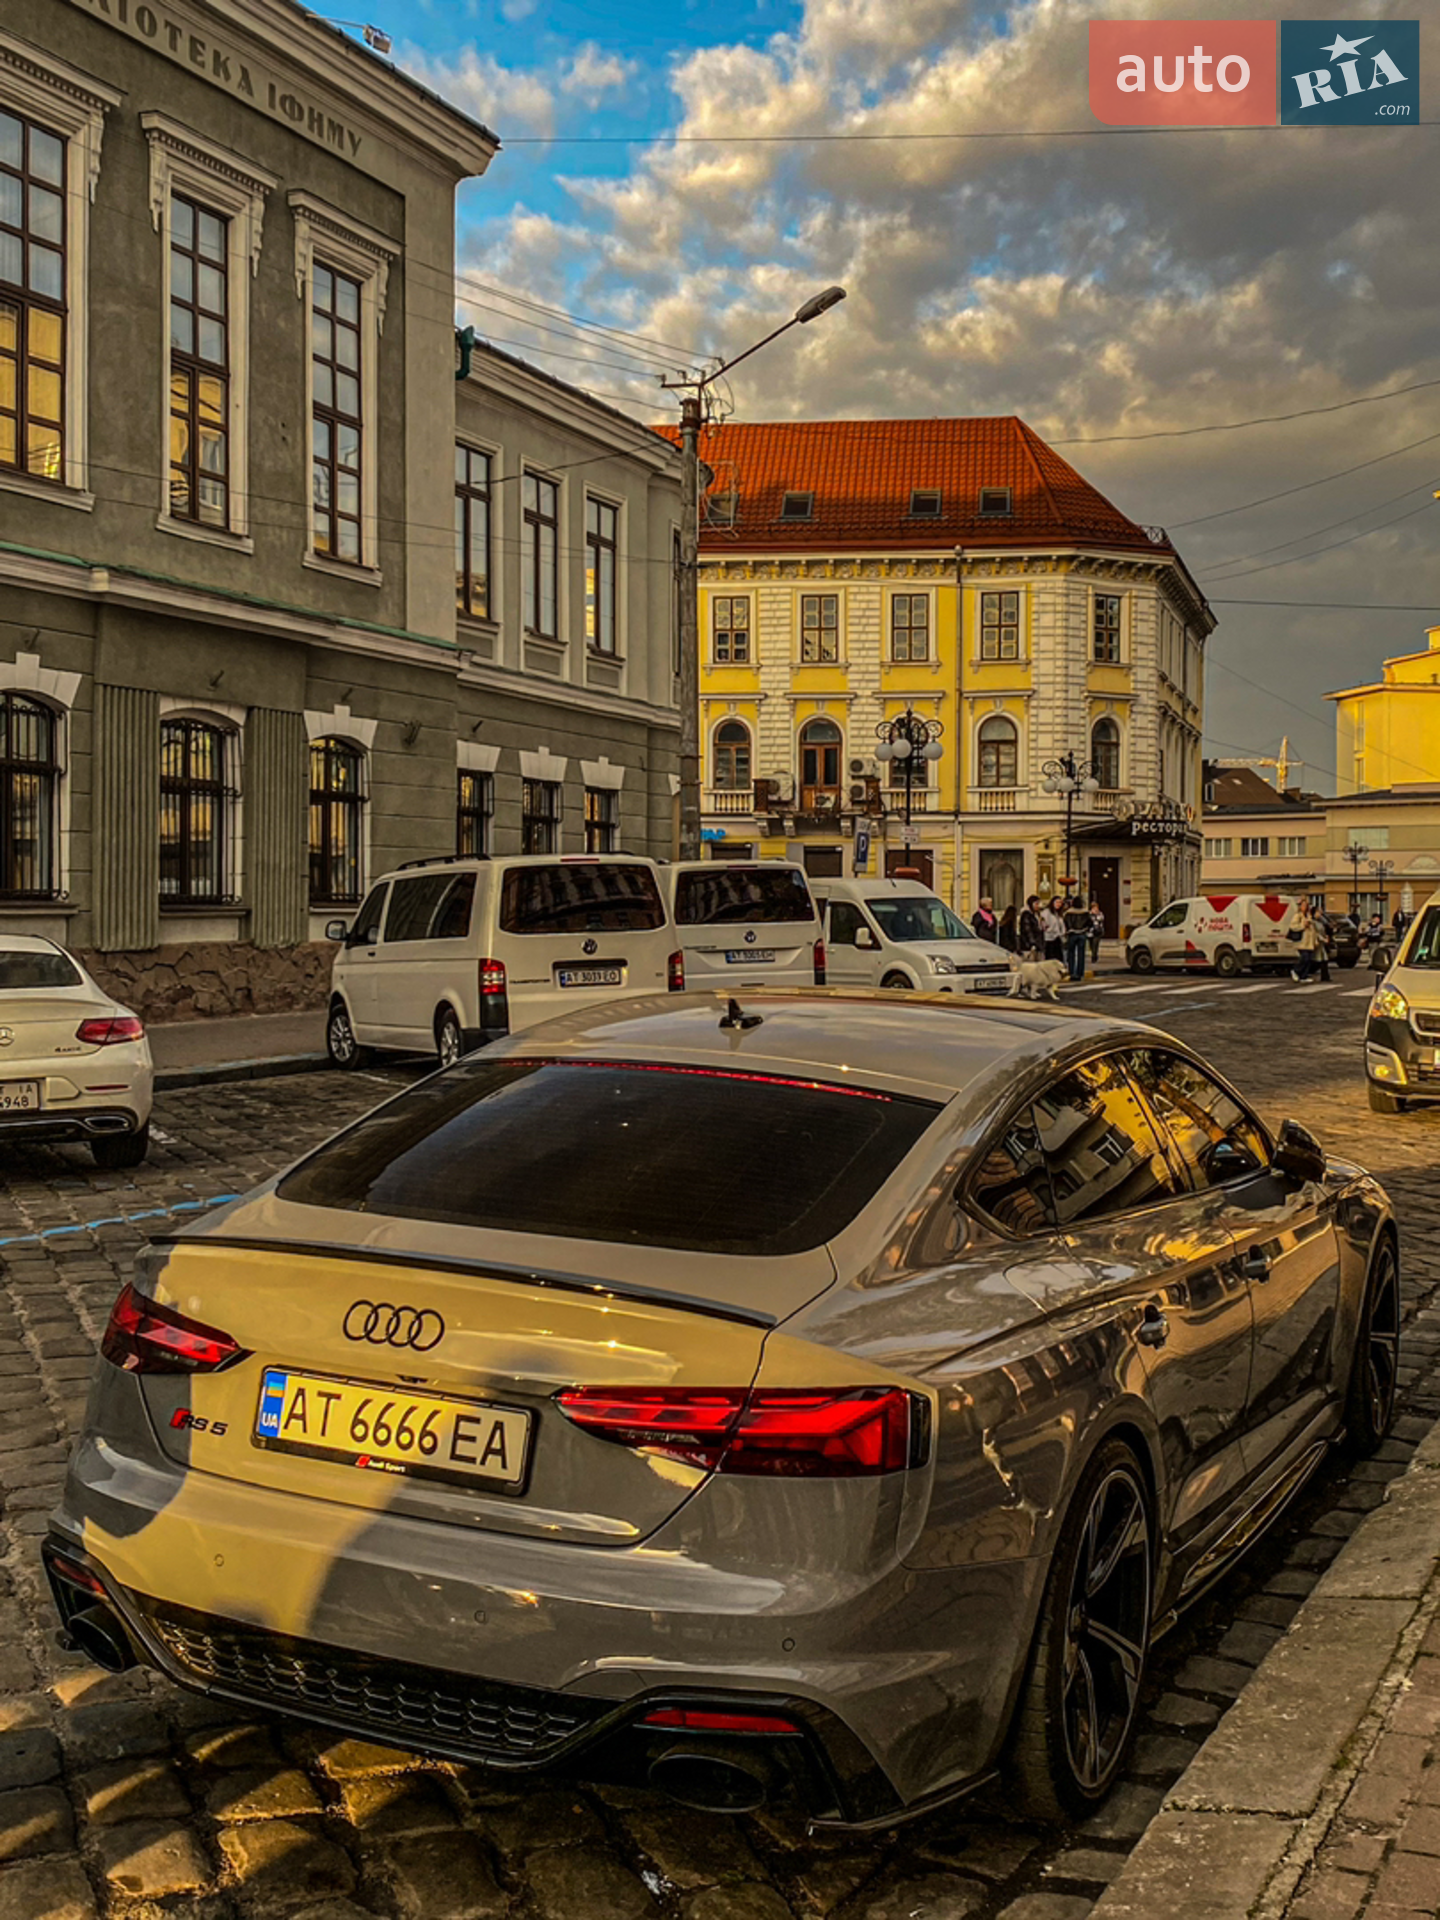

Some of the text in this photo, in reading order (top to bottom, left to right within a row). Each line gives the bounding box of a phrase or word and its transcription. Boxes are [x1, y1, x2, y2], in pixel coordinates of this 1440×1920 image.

[268, 82, 362, 157] ІФНМУ
[262, 1411, 278, 1428] UA
[283, 1387, 508, 1470] AT 6666 EA
